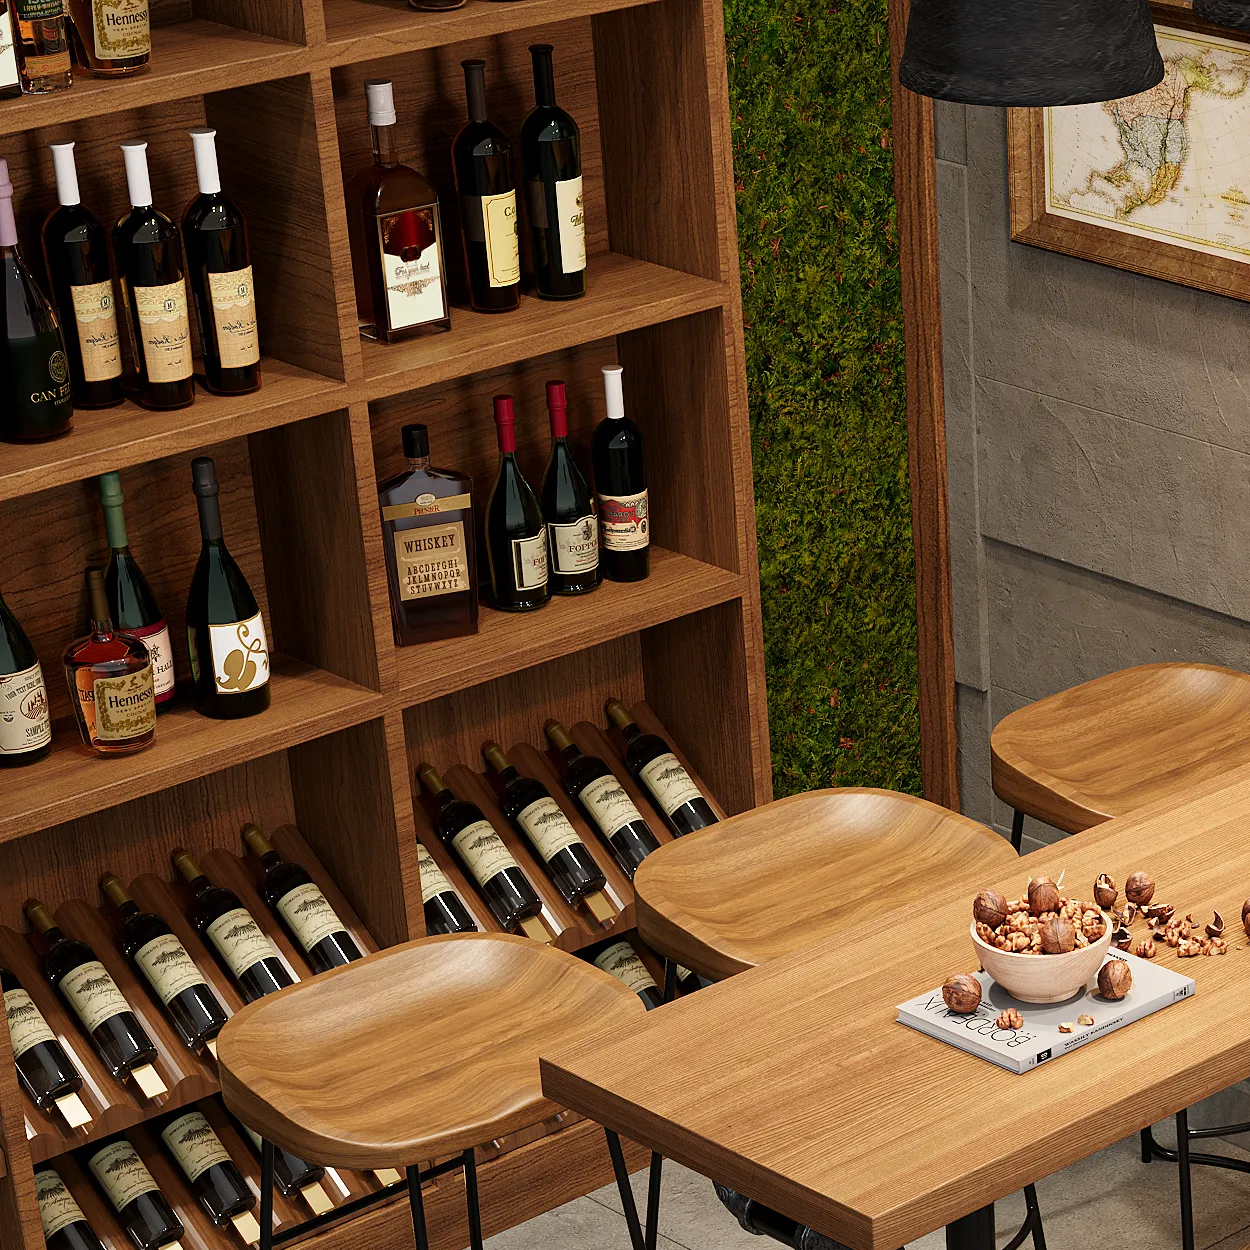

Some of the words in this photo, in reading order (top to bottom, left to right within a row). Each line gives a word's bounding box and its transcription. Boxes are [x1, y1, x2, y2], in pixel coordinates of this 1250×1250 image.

[31, 388, 57, 404] CAN
[404, 534, 455, 554] WHISKEY
[407, 559, 458, 576] ABCDEFGHI
[407, 568, 461, 586] JKLMNOPQR
[411, 579, 459, 595] STUVWXYZ
